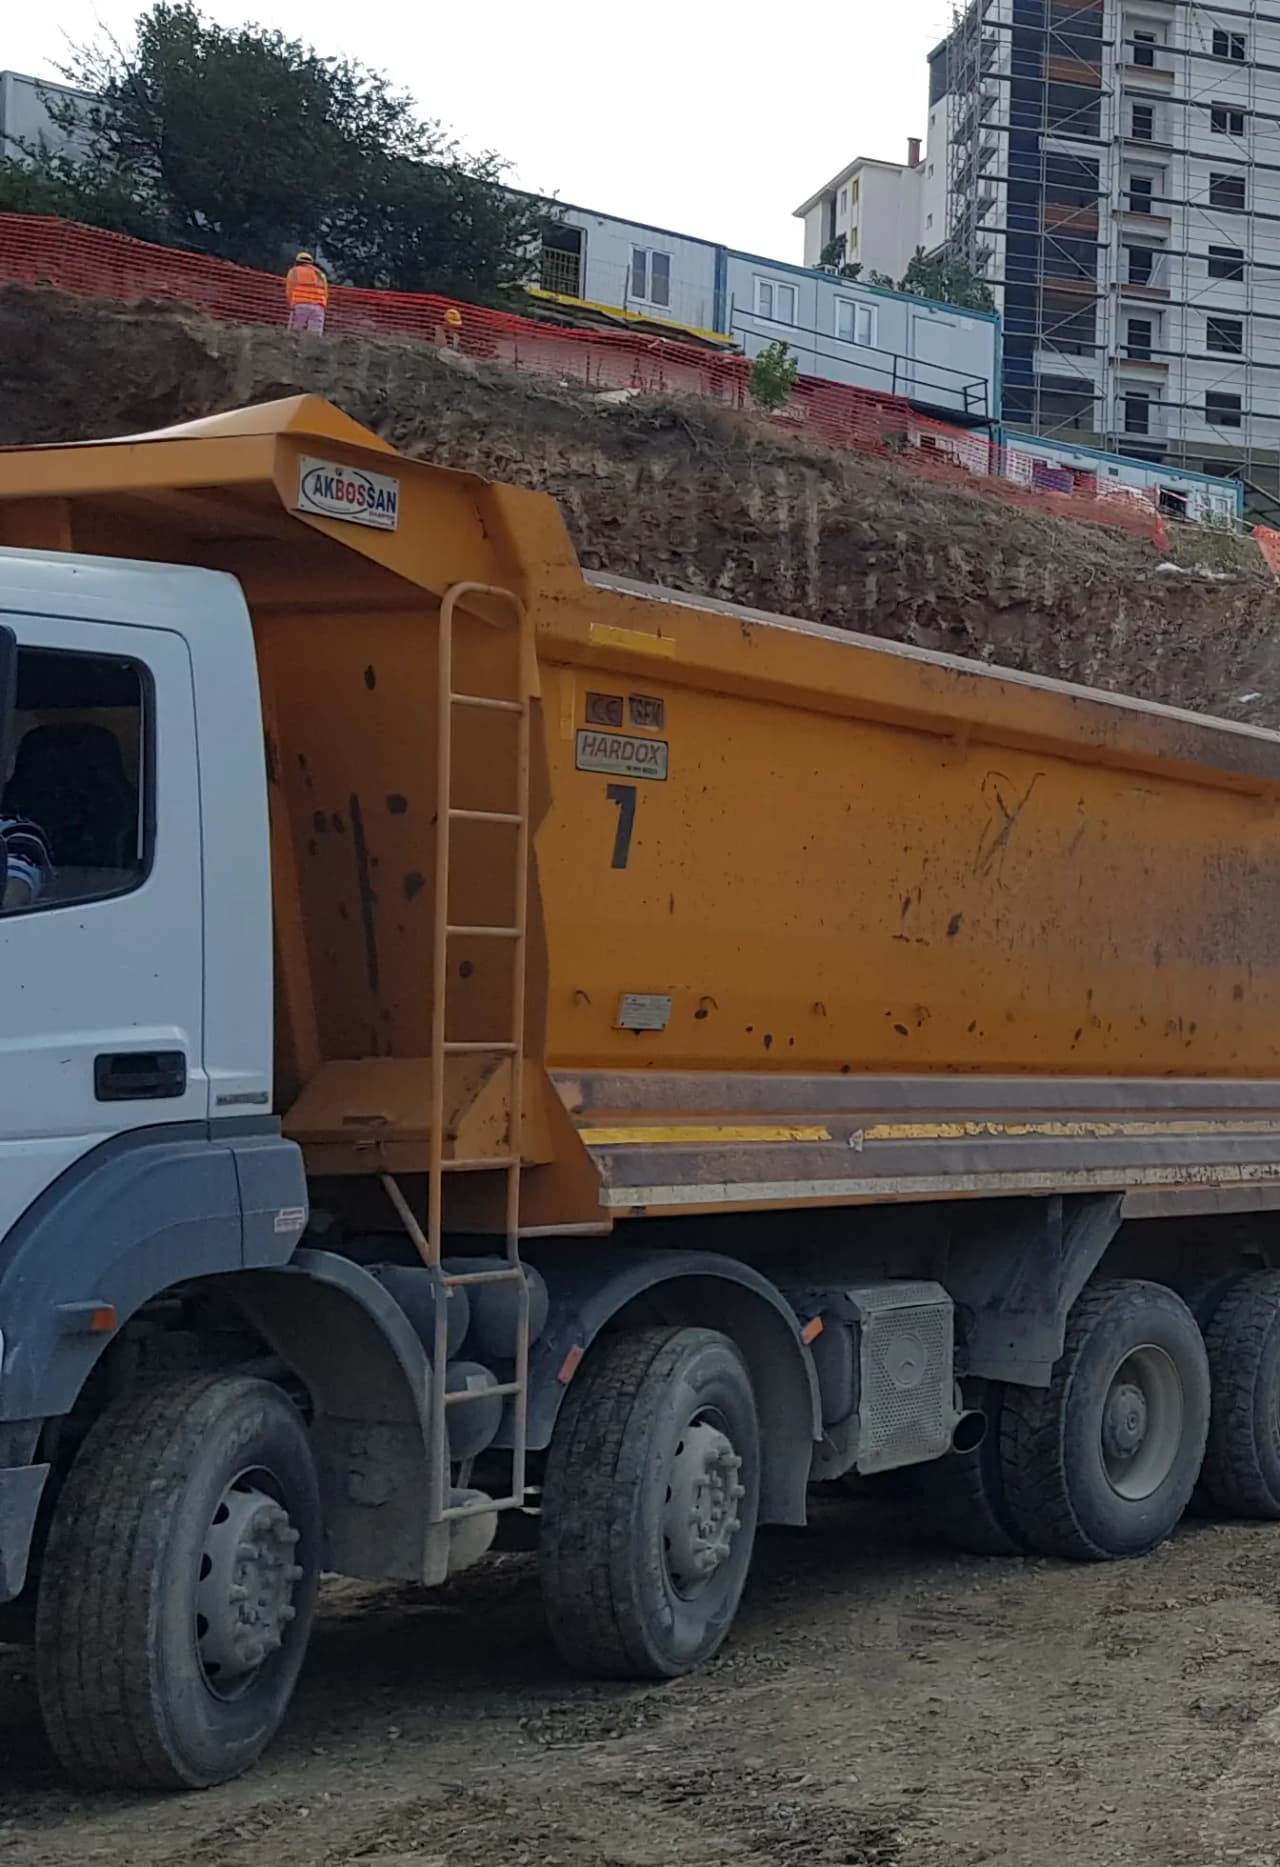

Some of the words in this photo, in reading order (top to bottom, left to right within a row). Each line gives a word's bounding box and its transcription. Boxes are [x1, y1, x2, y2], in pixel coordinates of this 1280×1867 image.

[313, 474, 397, 513] AKBOSSAN
[582, 735, 661, 765] HARDOX
[606, 783, 636, 868] 7
